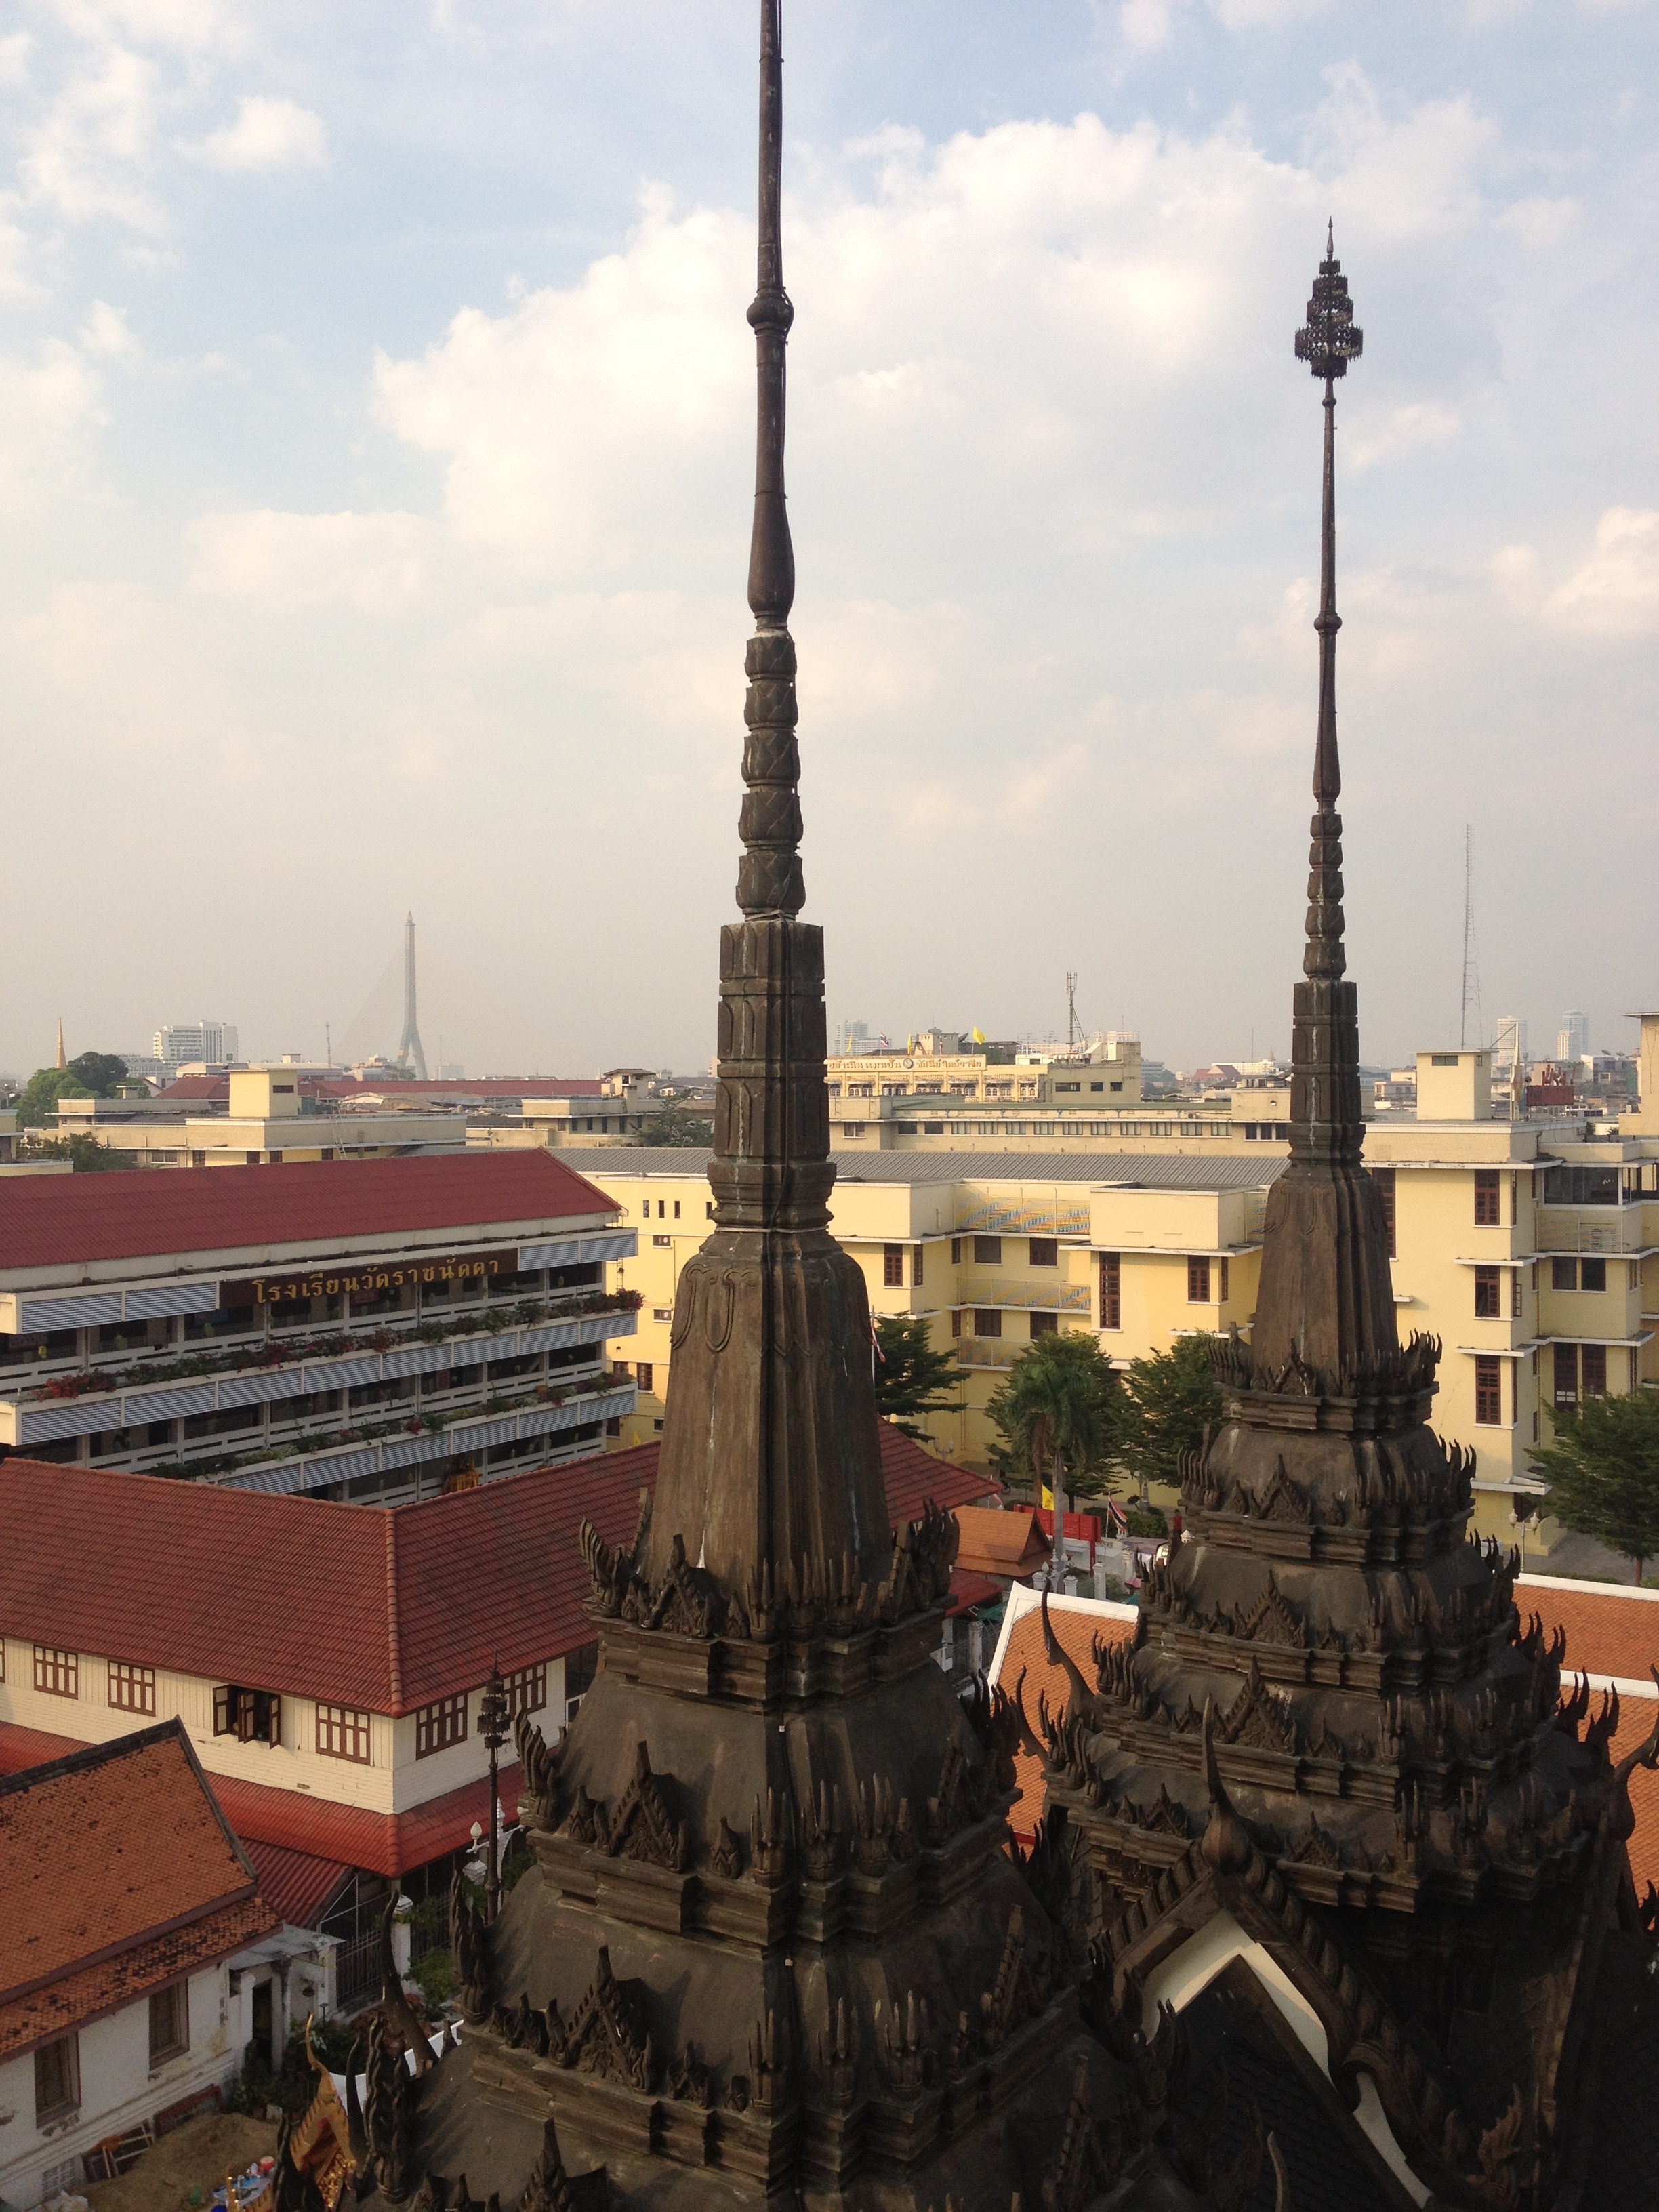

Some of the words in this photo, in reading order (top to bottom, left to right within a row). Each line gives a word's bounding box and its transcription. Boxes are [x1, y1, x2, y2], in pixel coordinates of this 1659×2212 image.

[251, 1257, 499, 1304] โรงเรียนวัดราชนัดดา
